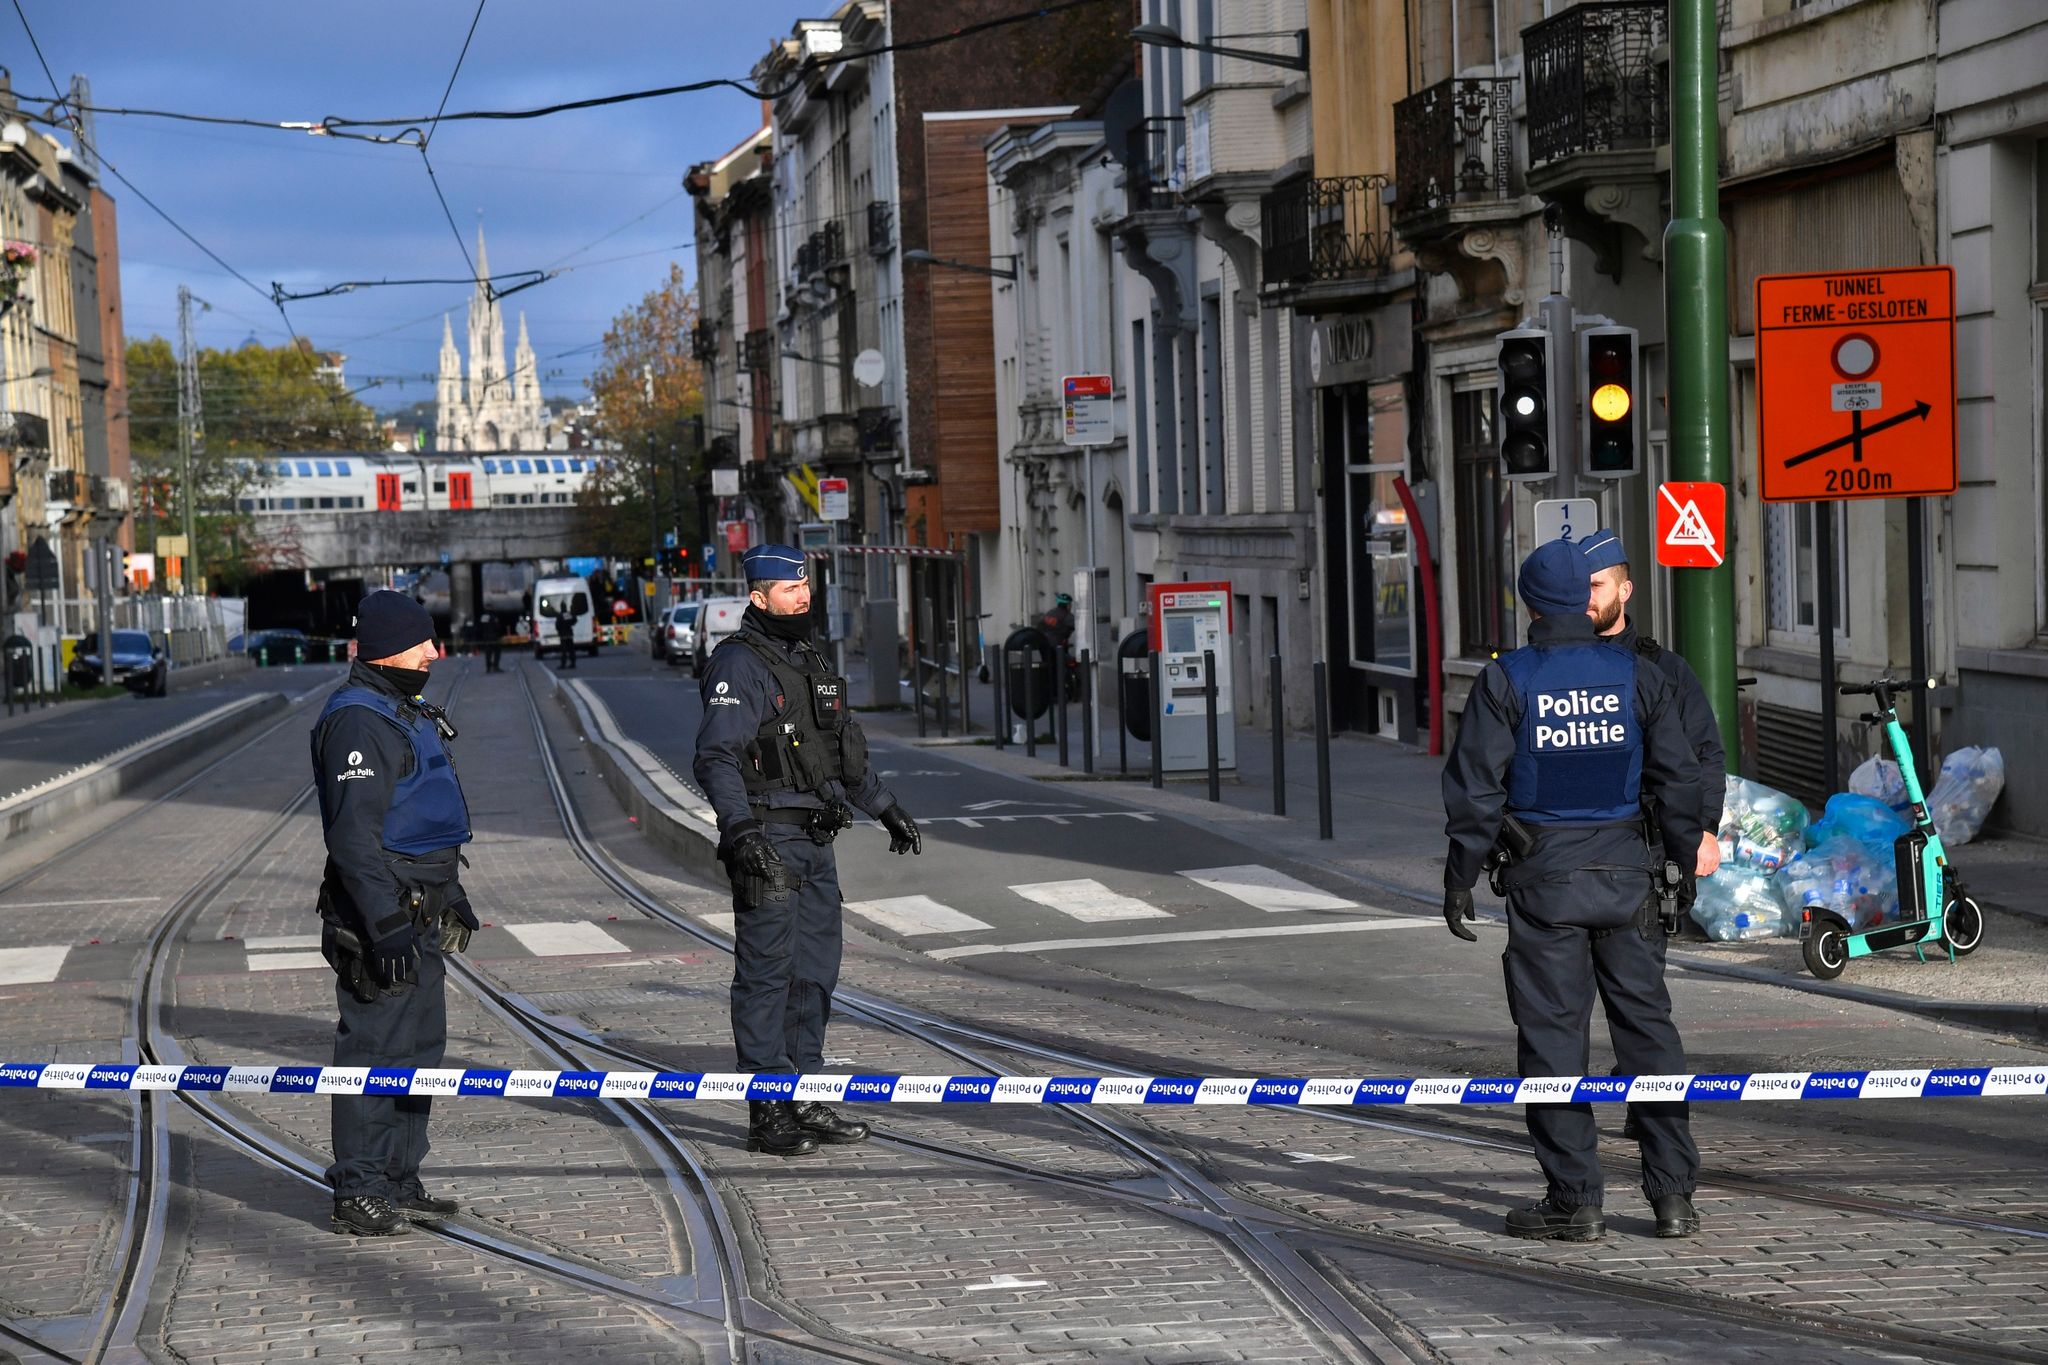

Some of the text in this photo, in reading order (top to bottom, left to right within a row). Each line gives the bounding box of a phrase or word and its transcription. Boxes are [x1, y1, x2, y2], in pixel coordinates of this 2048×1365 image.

[1825, 277, 1885, 297] TUNNEL
[1825, 468, 1893, 492] 200m
[1561, 504, 1569, 519] 1
[1561, 524, 1572, 540] 2
[704, 546, 715, 561] P
[817, 684, 838, 695] POLICE
[719, 696, 741, 705] Politie
[1537, 690, 1620, 718] Police
[1536, 719, 1625, 749] Politie
[44, 1070, 75, 1081] Politie
[91, 1071, 120, 1082] Police
[136, 1072, 167, 1083] Politie
[183, 1073, 212, 1084] Police
[228, 1074, 259, 1085] Politie
[275, 1074, 304, 1086] Police
[321, 1075, 352, 1087] Politie
[1930, 1075, 1968, 1087] Police
[1990, 1073, 2032, 1085] Politie
[369, 1076, 398, 1088] Police
[415, 1077, 447, 1088] Politie
[463, 1077, 493, 1089] Police
[510, 1078, 542, 1089] Politie
[559, 1078, 588, 1090] Police
[605, 1079, 638, 1091] Politie
[655, 1080, 685, 1092] Police
[702, 1081, 735, 1092] Politie
[752, 1081, 782, 1093] Police
[799, 1082, 832, 1093] Politie
[850, 1082, 880, 1094] Police
[1522, 1082, 1560, 1094] Politie
[1580, 1082, 1614, 1093] Police
[1634, 1081, 1672, 1092] Politie
[1693, 1080, 1728, 1092] Police
[1749, 1079, 1788, 1090] Politie
[1809, 1078, 1846, 1090] Police
[1868, 1077, 1908, 1088] Politie
[898, 1083, 931, 1094] Politie
[949, 1083, 980, 1095] Police
[998, 1083, 1031, 1095] Politie
[1049, 1083, 1081, 1095] Police
[1099, 1084, 1133, 1095] Politie
[1151, 1084, 1183, 1096] Police
[1202, 1084, 1237, 1096] Politie
[1255, 1084, 1288, 1096] Police
[1306, 1085, 1342, 1096] Politie
[1361, 1084, 1394, 1096] Police
[1413, 1084, 1450, 1095] Politie
[1469, 1083, 1503, 1095] Police
